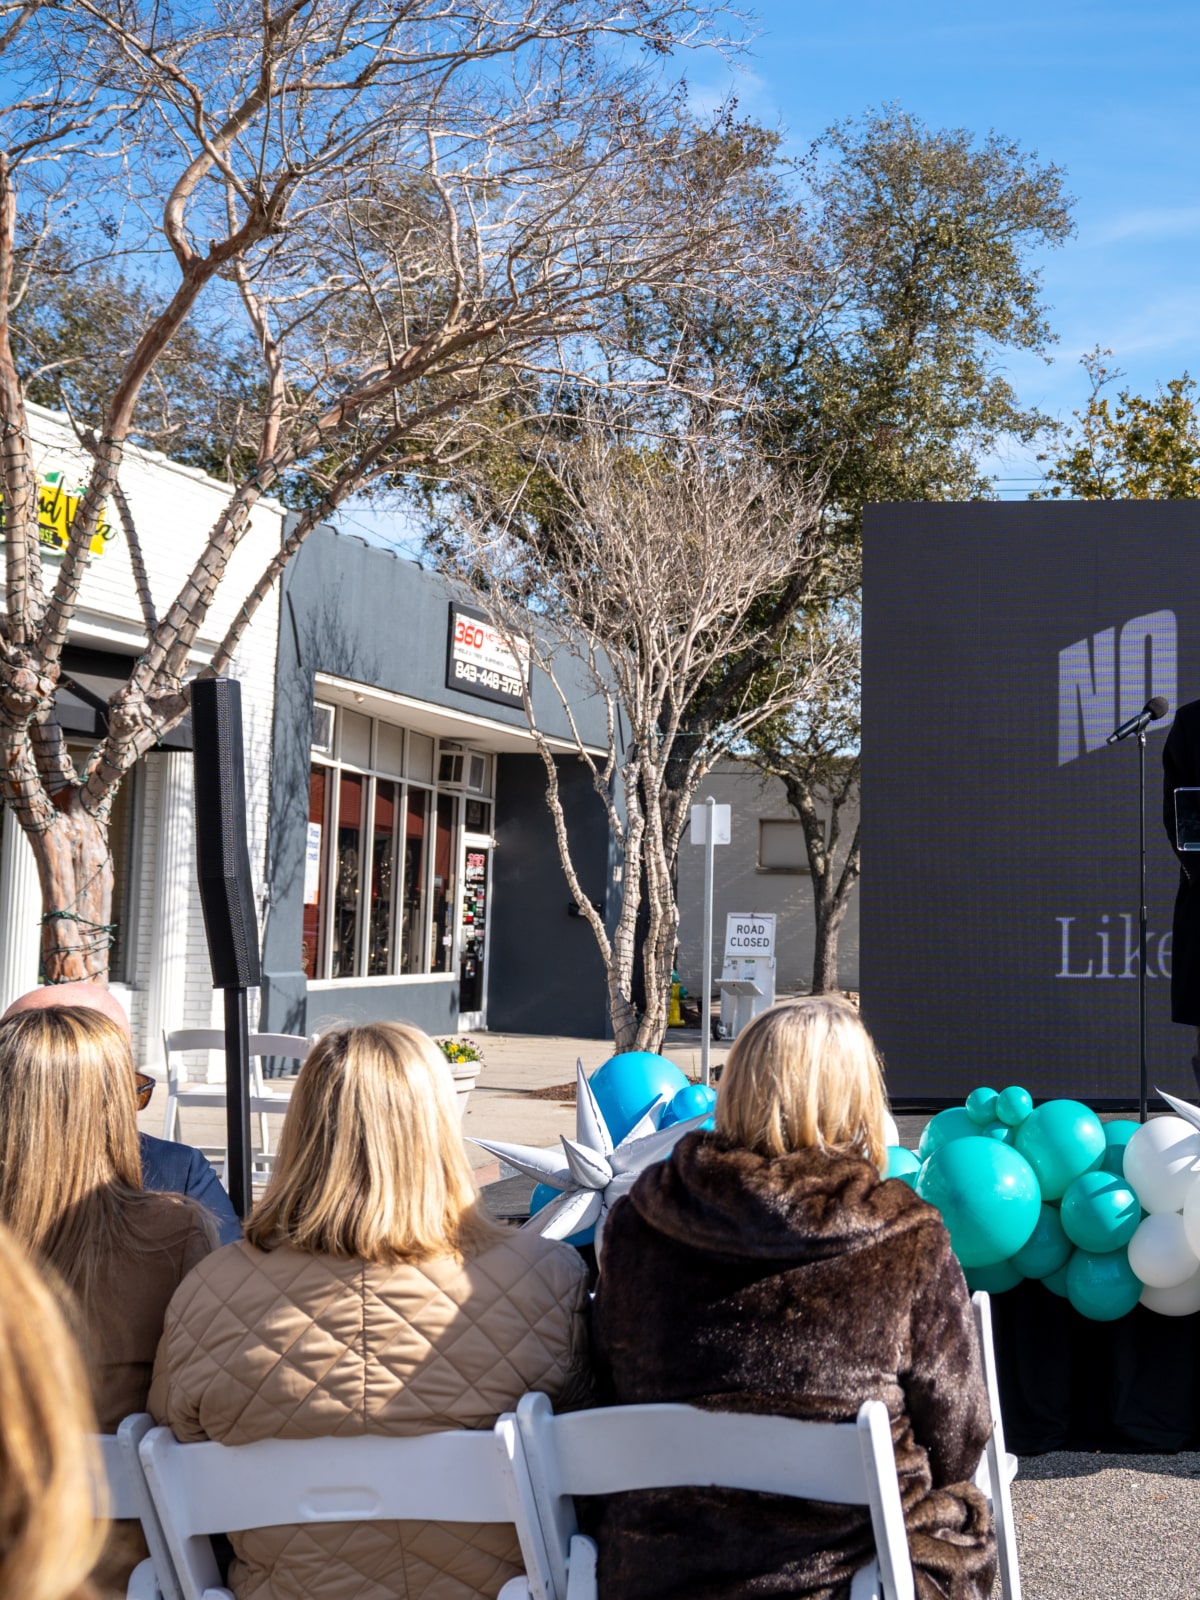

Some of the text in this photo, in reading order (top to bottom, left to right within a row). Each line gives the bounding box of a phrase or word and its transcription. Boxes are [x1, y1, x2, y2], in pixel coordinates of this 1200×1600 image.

[454, 622, 484, 649] 360
[1058, 609, 1177, 767] NO
[736, 924, 765, 935] ROAD
[730, 937, 770, 948] CLOSED
